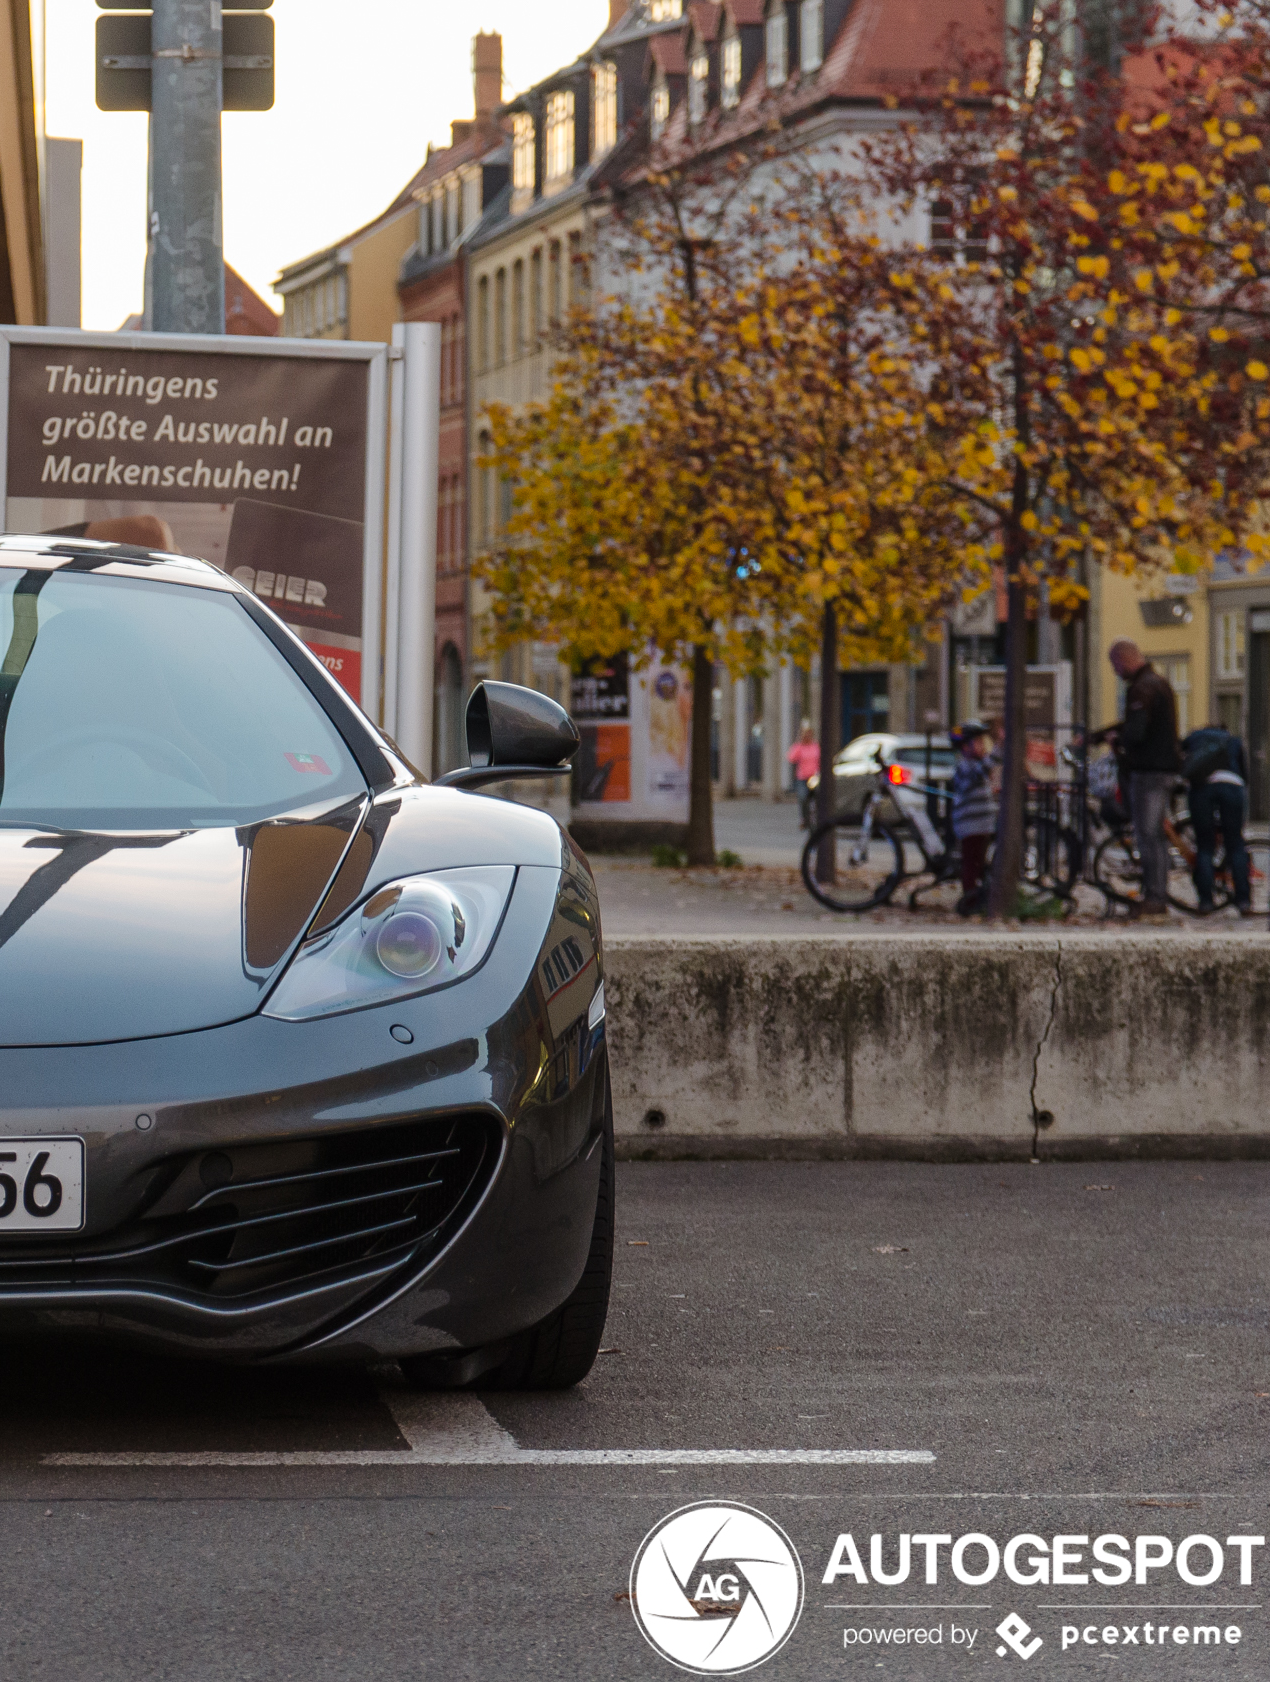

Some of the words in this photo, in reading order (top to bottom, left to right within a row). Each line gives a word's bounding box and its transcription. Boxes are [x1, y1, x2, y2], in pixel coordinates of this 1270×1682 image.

[45, 364, 219, 405] Thüringens
[42, 410, 148, 446] größte
[153, 414, 289, 446] Auswahl
[294, 426, 333, 448] an
[41, 455, 302, 491] Markenschuhen!
